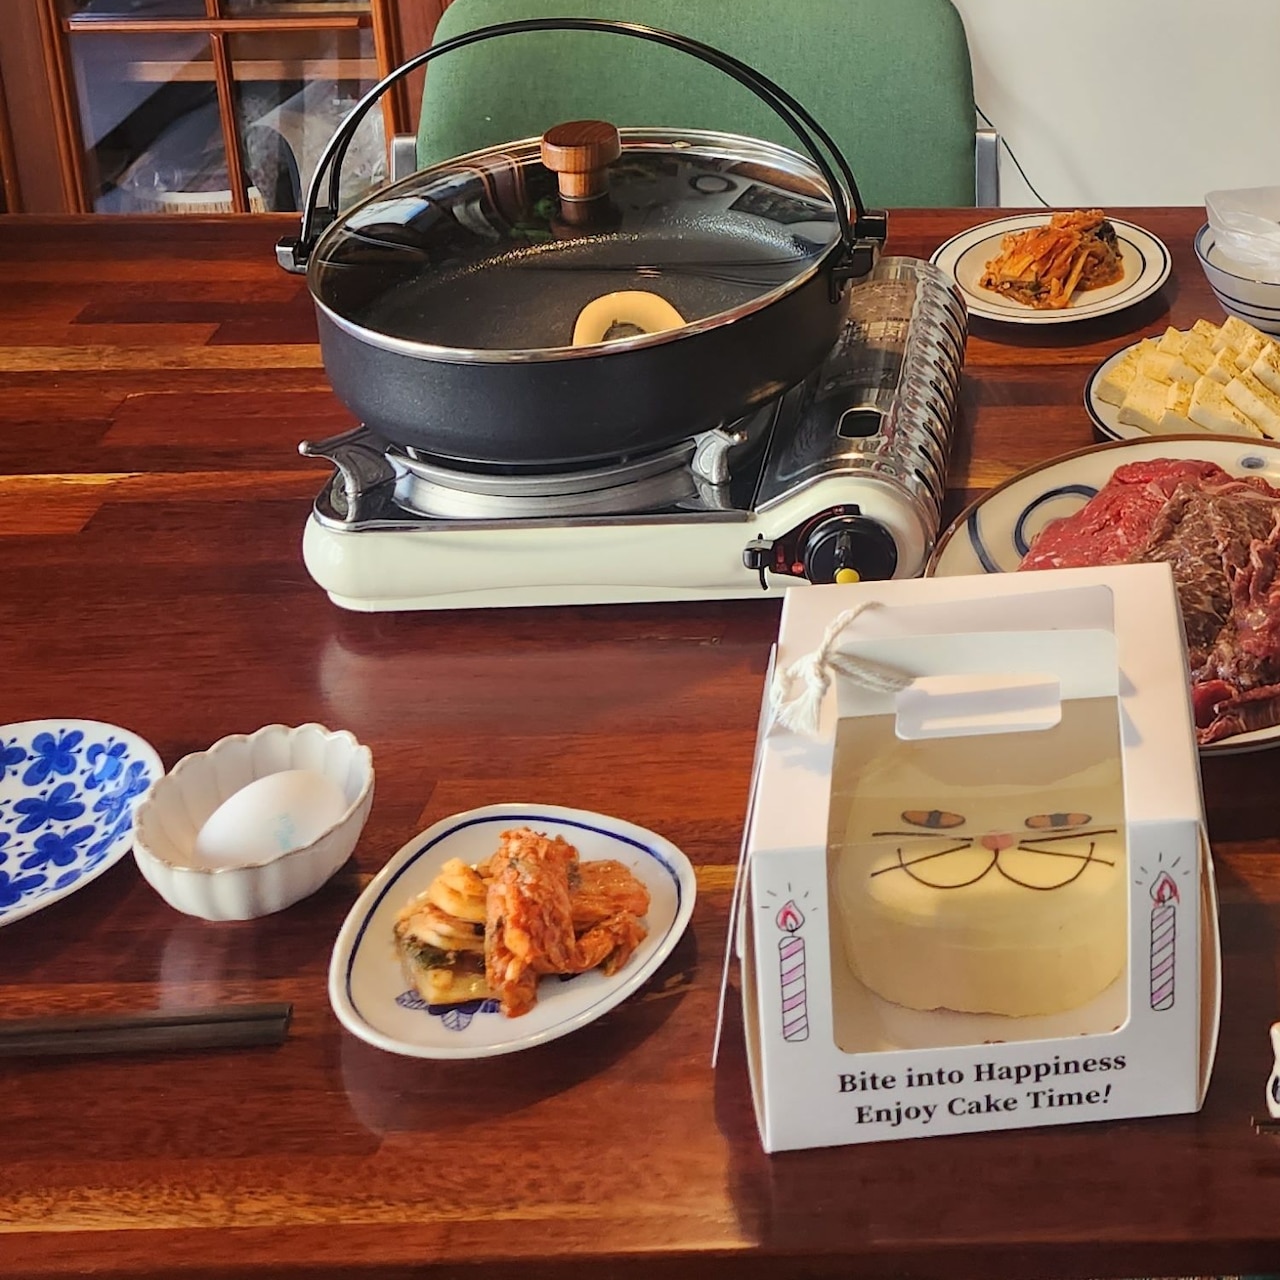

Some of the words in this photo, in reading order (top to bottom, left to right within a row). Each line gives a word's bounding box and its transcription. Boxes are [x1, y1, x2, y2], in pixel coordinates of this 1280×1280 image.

[838, 1071, 896, 1093] Bite
[906, 1067, 964, 1088] into
[973, 1054, 1127, 1084] Happiness
[854, 1101, 938, 1127] Enjoy
[947, 1094, 1018, 1116] Cake
[1025, 1084, 1112, 1110] Time!
